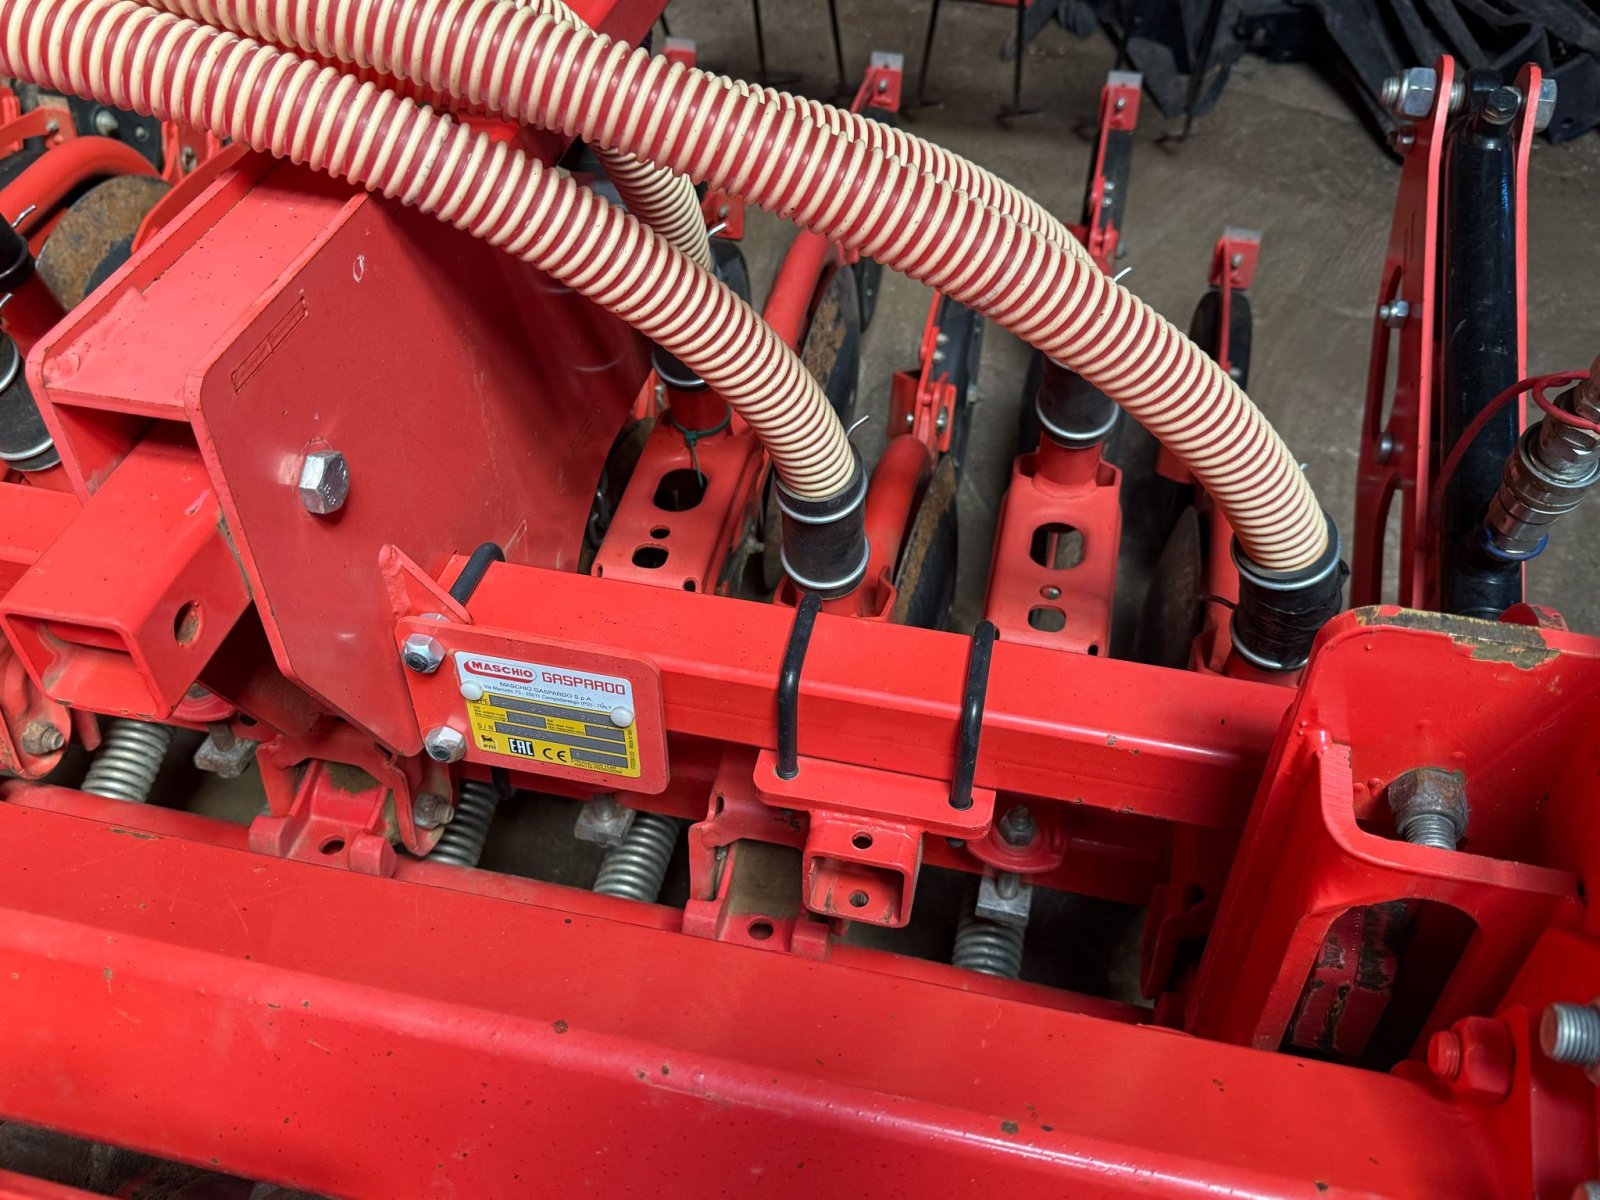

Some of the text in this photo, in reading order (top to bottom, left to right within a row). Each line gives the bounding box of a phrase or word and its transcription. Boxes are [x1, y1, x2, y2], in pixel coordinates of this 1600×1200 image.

[471, 661, 626, 695] MASCHIO GASPARDO
[500, 682, 532, 691] MASCHIO
[533, 687, 573, 699] GASPARDO
[542, 747, 568, 763] CE
